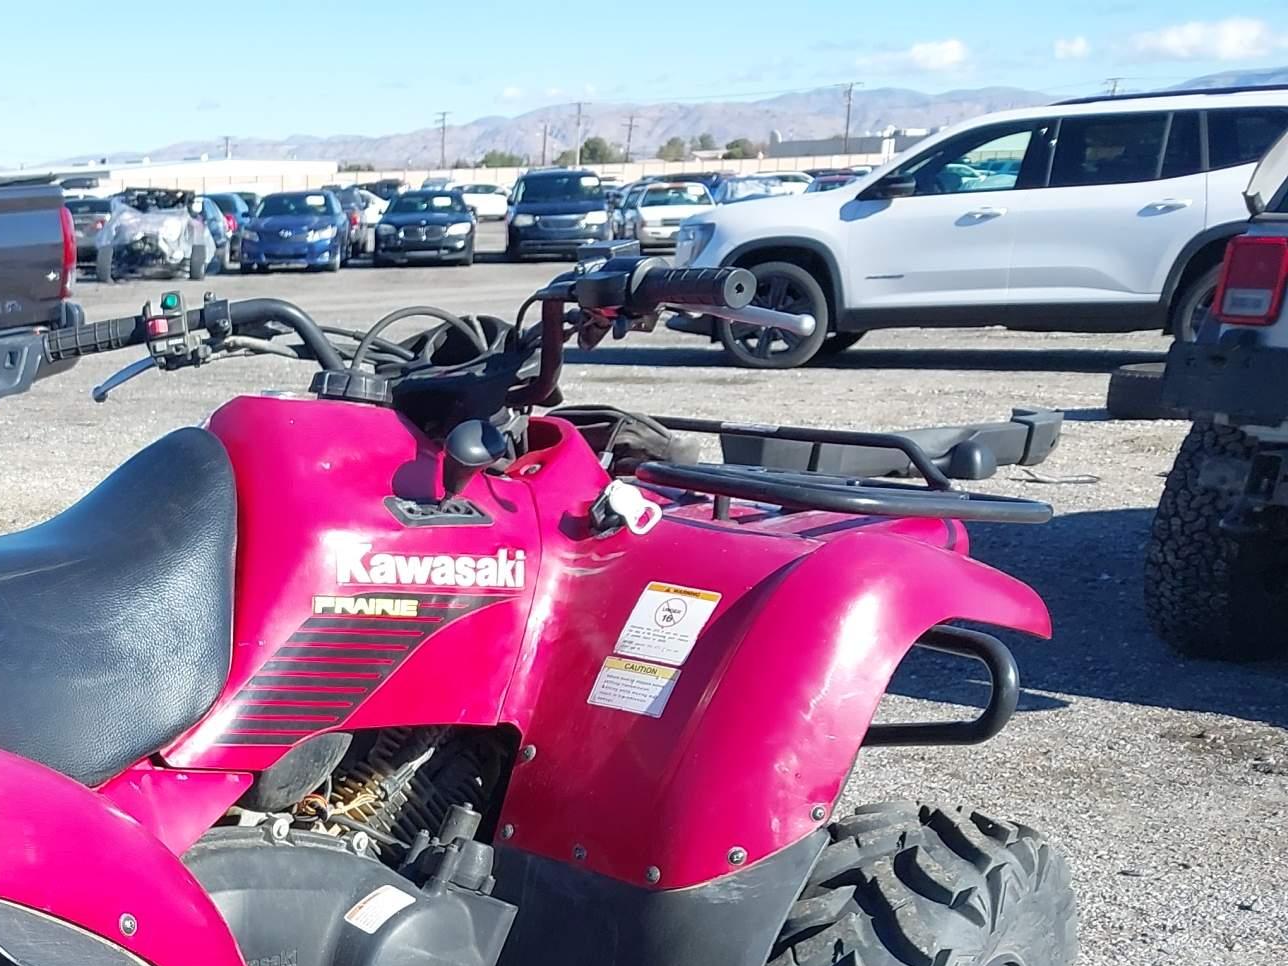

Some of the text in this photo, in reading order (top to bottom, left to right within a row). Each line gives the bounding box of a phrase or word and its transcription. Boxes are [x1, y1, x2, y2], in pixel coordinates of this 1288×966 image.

[336, 543, 527, 588] Kawasaki
[313, 596, 419, 617] PRAIRIE
[661, 613, 673, 623] 16
[623, 662, 658, 676] CAUTION
